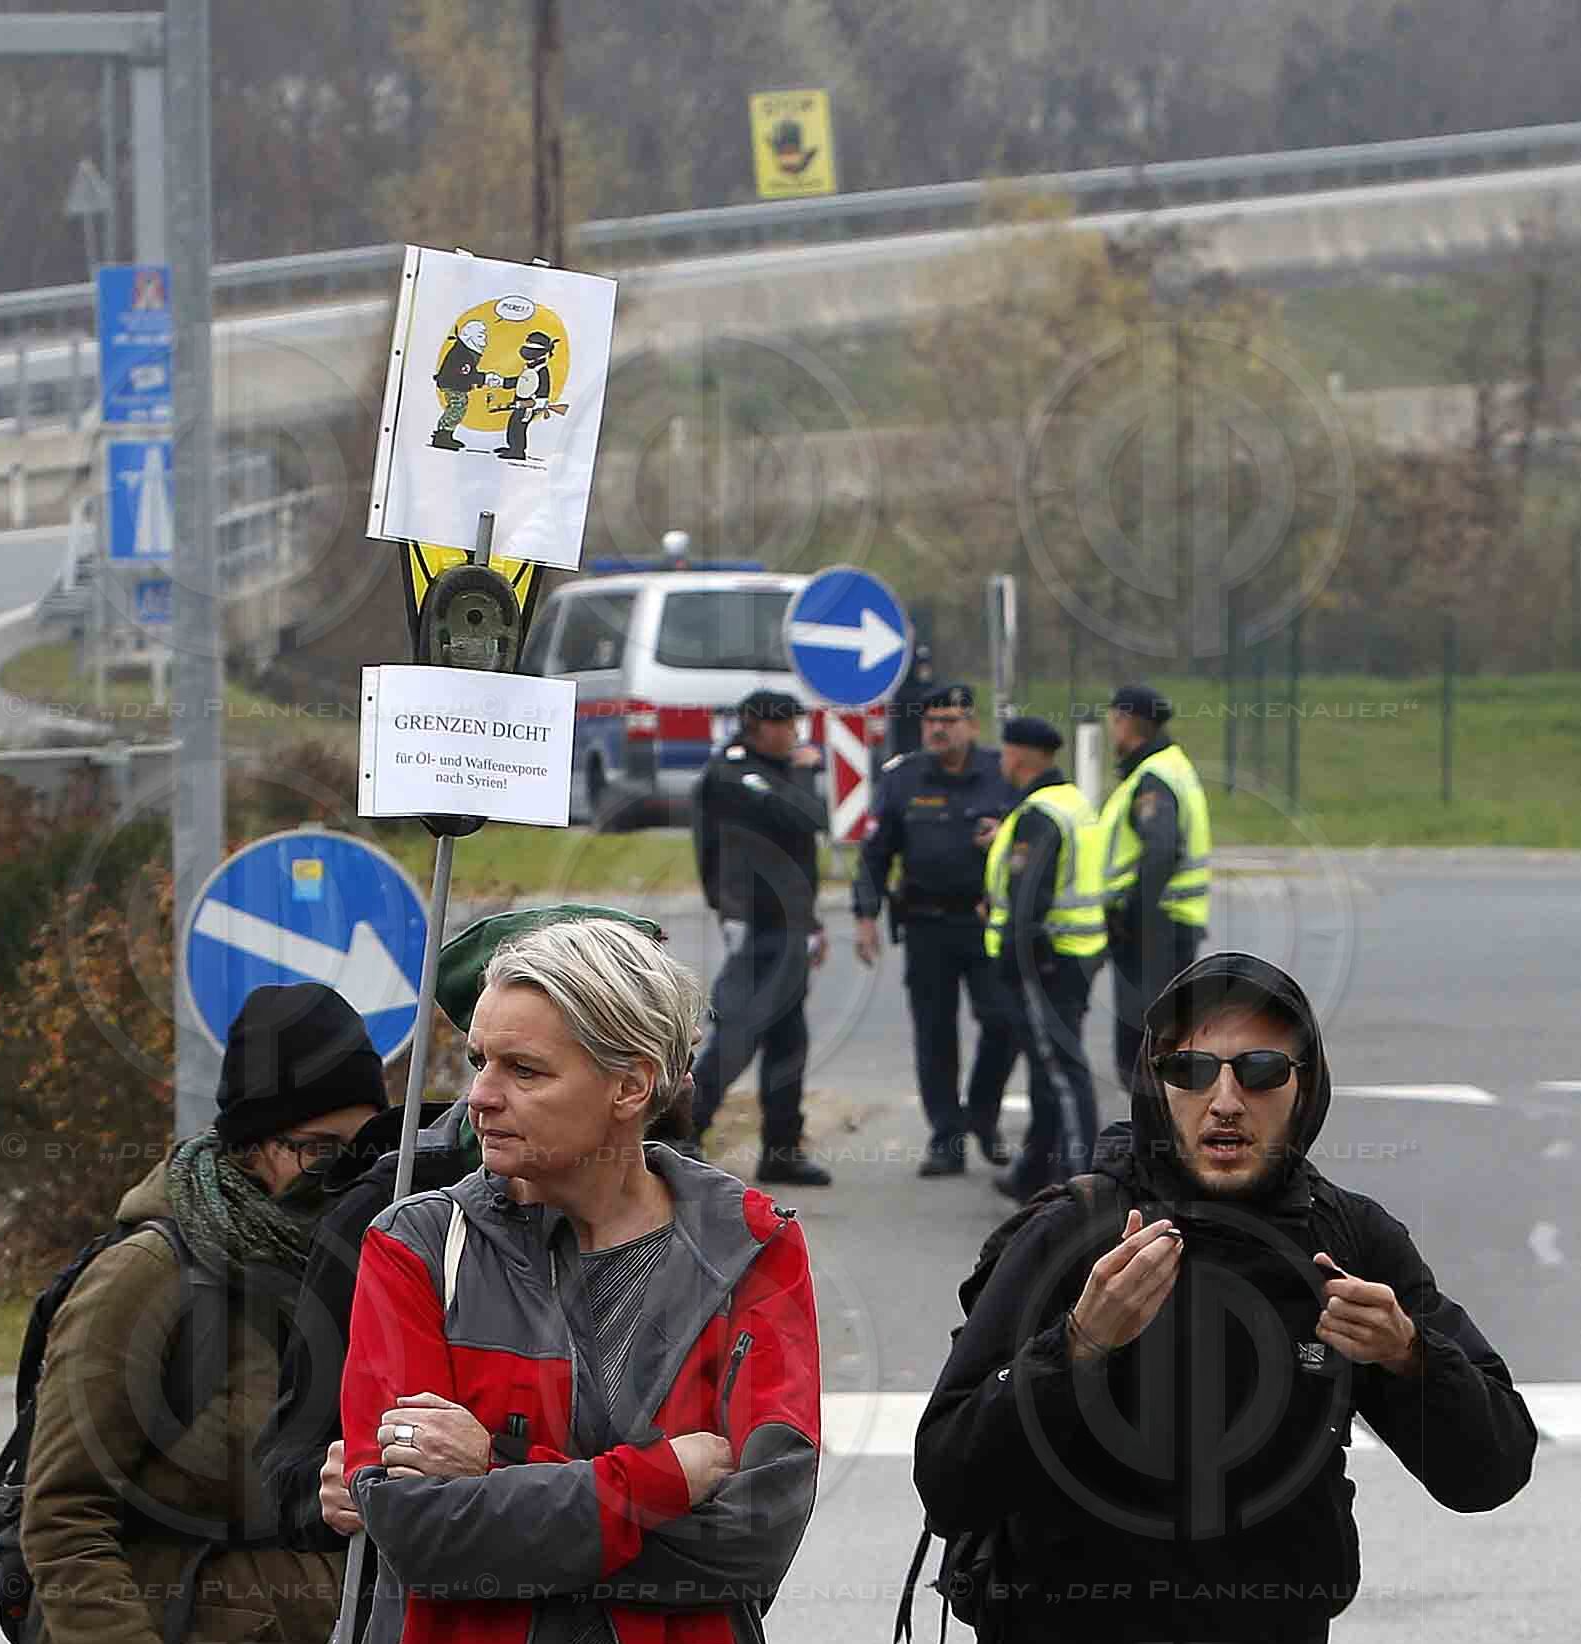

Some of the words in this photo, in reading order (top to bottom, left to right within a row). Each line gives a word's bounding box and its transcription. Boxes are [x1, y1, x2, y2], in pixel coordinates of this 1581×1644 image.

[394, 713, 487, 736] GRENZEN
[492, 721, 551, 742] DICHT
[395, 751, 413, 765] für
[439, 755, 462, 768] und
[466, 756, 548, 777] Waffenexporte
[435, 771, 463, 785] nach
[467, 773, 508, 791] Syrien!
